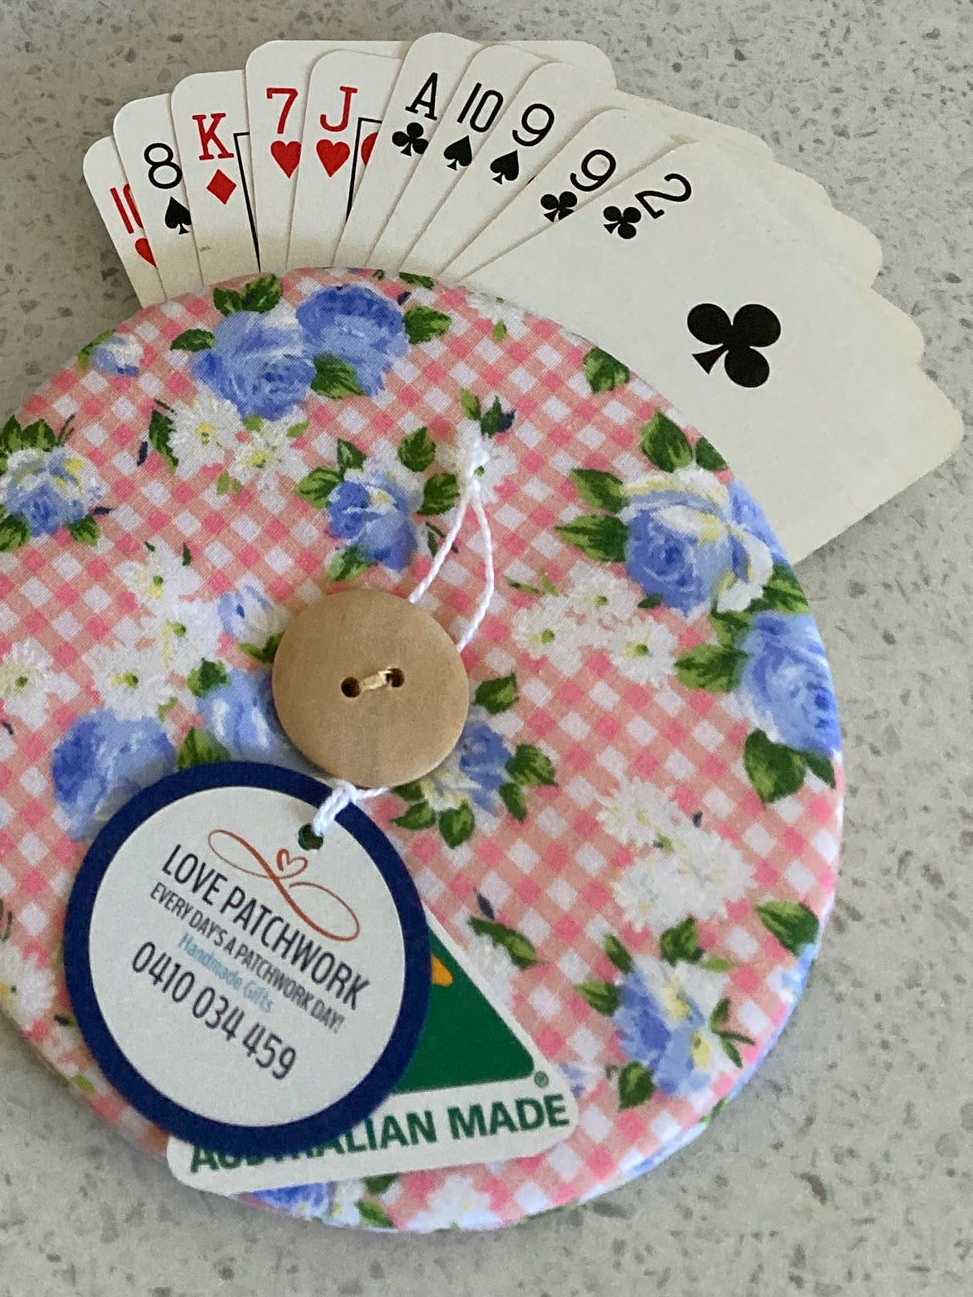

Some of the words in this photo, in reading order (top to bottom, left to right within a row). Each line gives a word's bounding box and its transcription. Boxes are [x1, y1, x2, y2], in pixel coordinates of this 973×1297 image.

[266, 88, 298, 134] 7
[320, 86, 357, 132] J
[405, 72, 438, 121] A
[457, 82, 503, 133] 10
[192, 113, 235, 160] K
[512, 103, 555, 146] 9
[144, 143, 182, 189] 8
[570, 149, 616, 192] 9
[635, 173, 692, 219] 2
[162, 844, 228, 906] LOVE
[220, 886, 370, 1010] PATCHWORK
[150, 882, 195, 919] EVERY
[189, 911, 228, 946] DAY'S
[226, 938, 236, 955] A
[237, 944, 314, 1012] PATCHWORK
[310, 1000, 345, 1034] DAY!
[178, 932, 243, 991] Handmade
[243, 980, 273, 1013] Gifts
[132, 942, 195, 1003] 0410
[192, 987, 245, 1042] 034
[242, 1023, 296, 1080] 459
[447, 1094, 570, 1139] MADE
